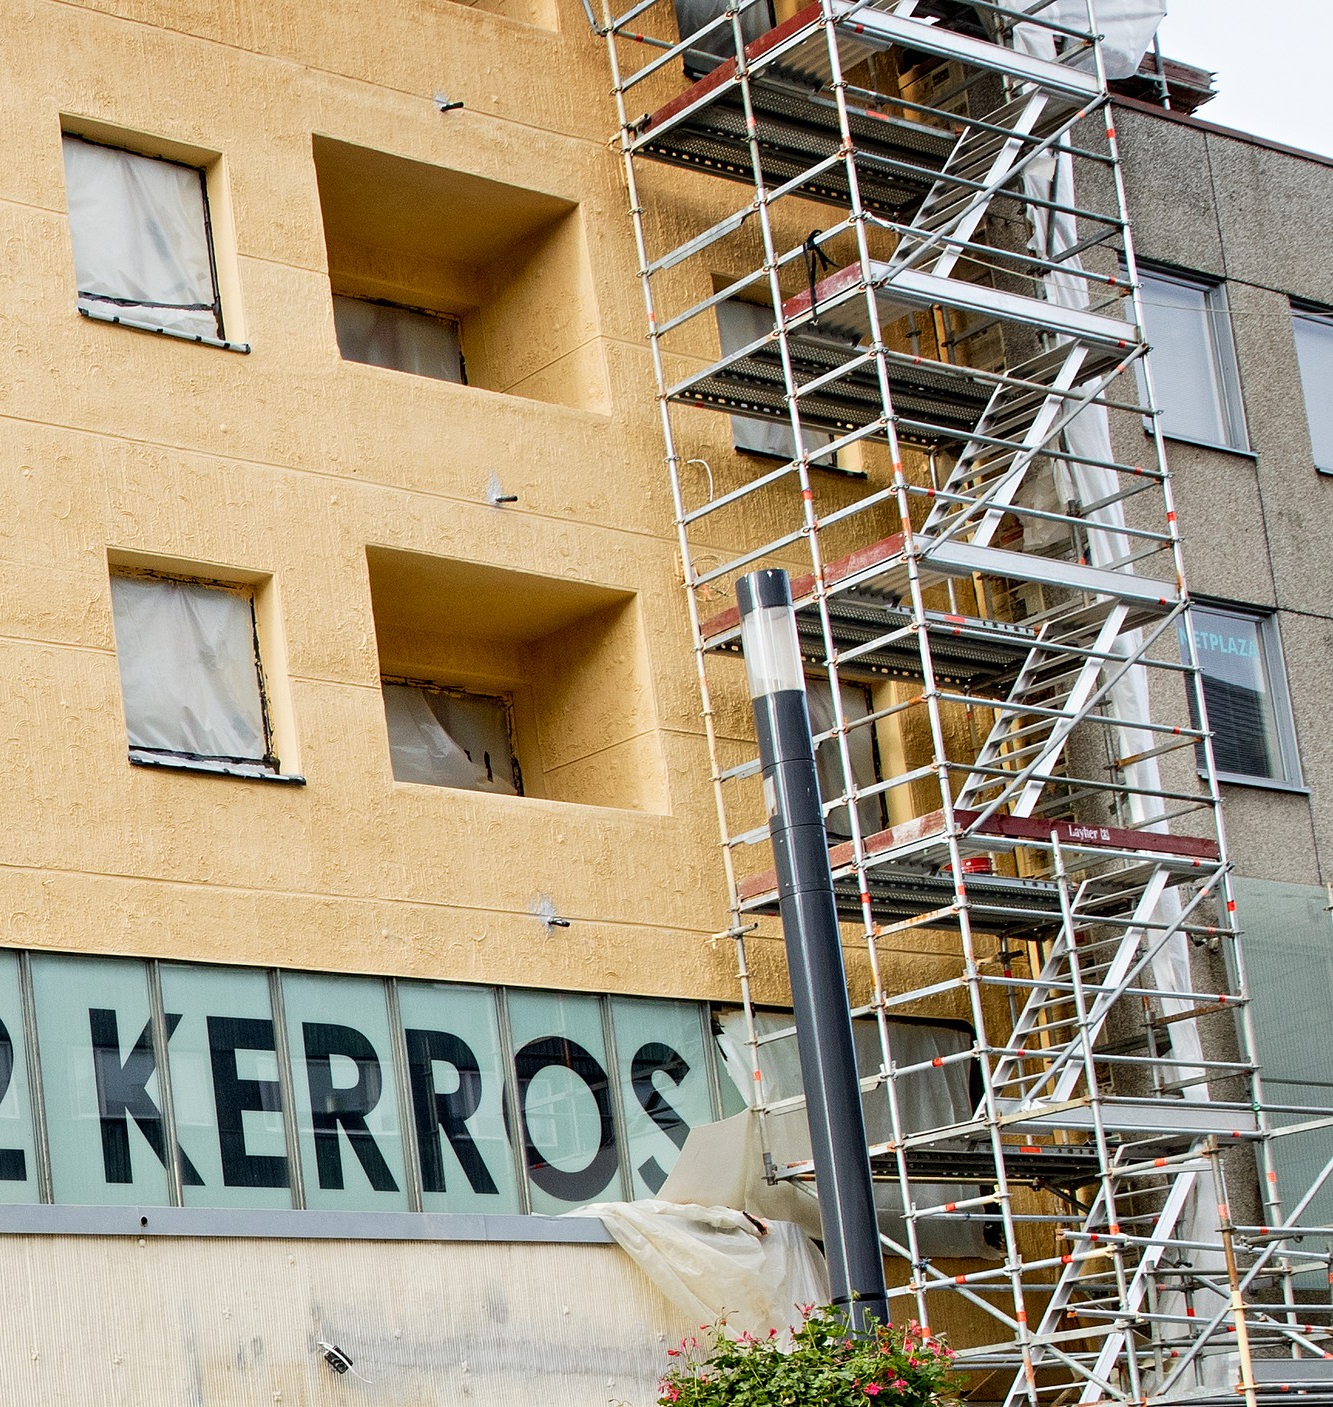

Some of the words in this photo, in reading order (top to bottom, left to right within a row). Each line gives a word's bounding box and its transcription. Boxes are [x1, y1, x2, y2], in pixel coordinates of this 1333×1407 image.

[1178, 628, 1258, 657] NETPLAZA
[1068, 824, 1098, 840] Layher
[87, 1007, 693, 1201] KERROS
